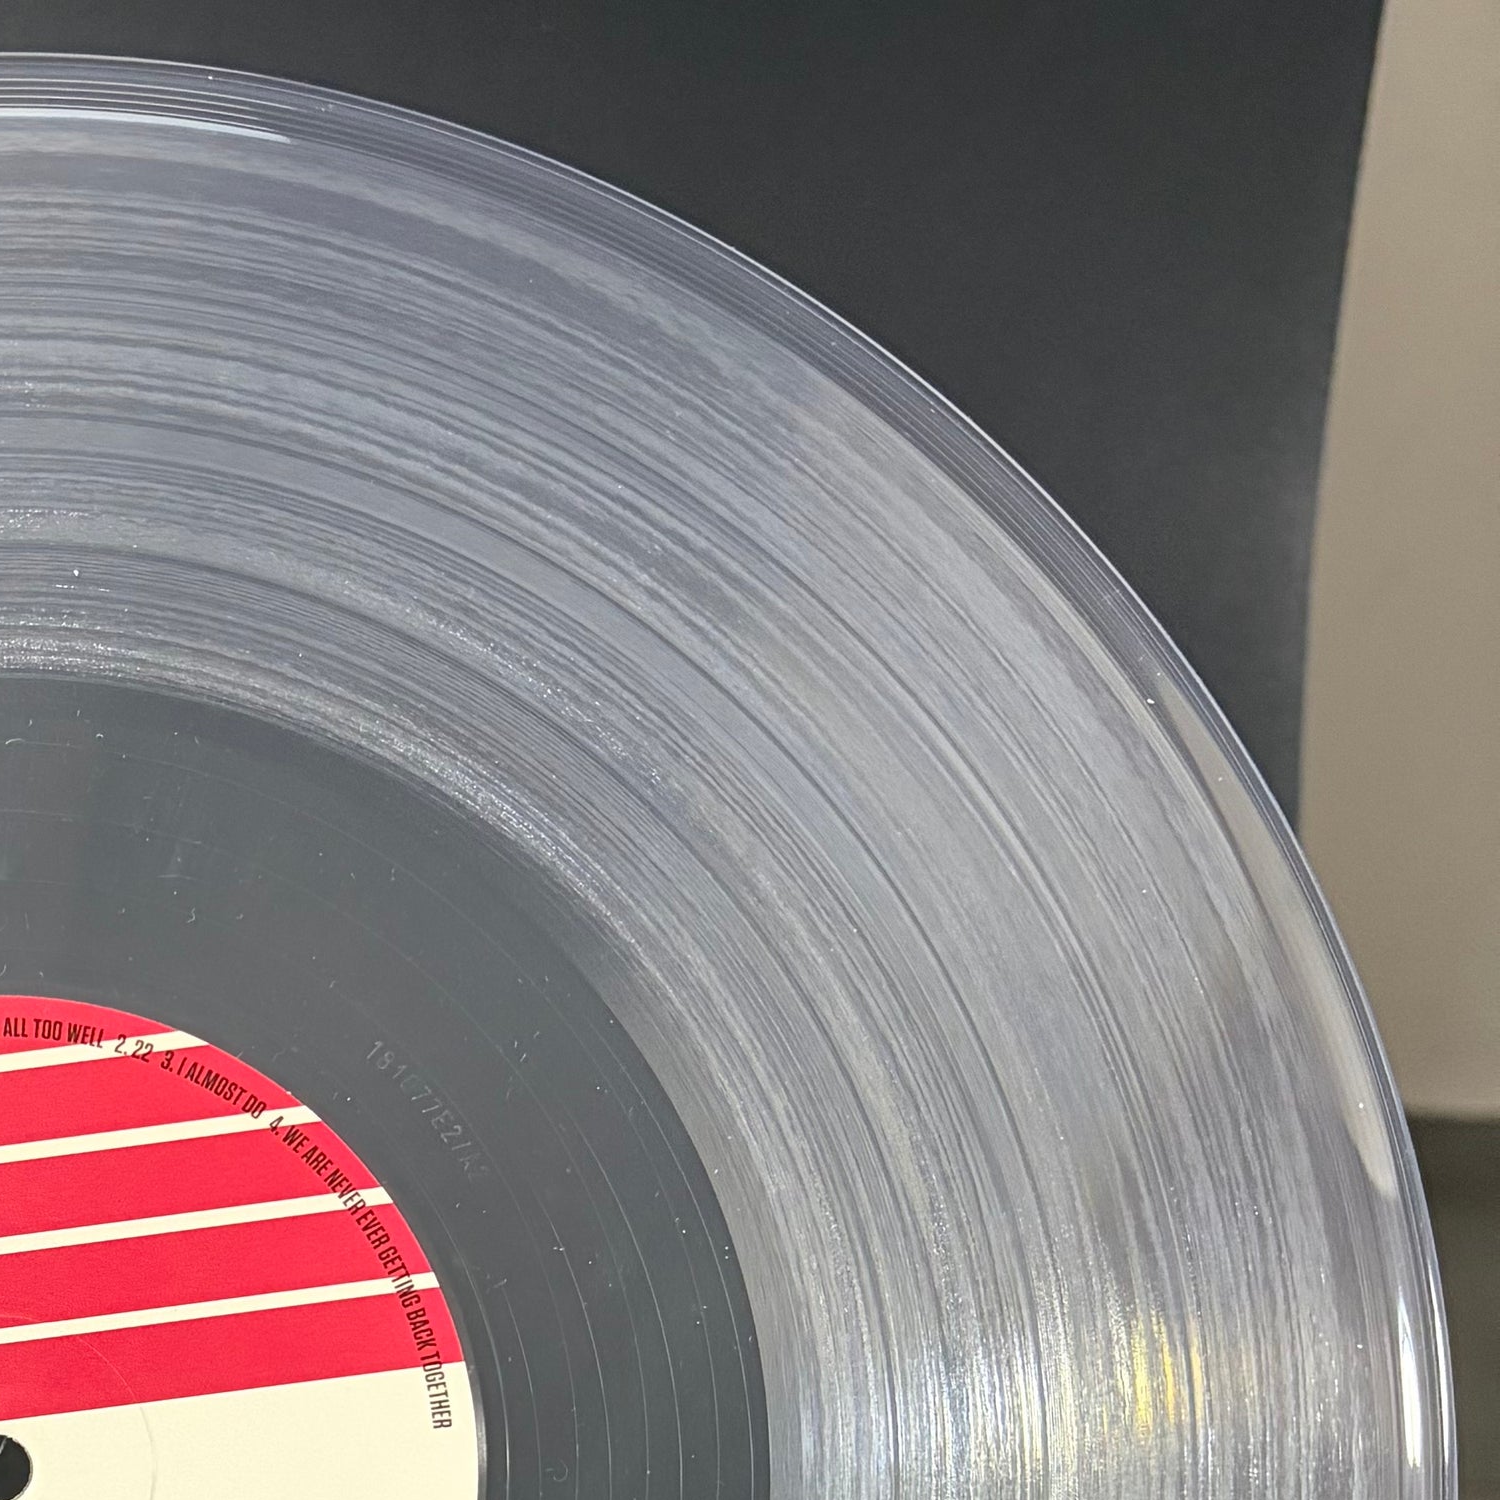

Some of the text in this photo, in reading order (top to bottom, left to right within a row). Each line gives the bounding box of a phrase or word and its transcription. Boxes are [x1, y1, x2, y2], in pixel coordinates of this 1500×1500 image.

[2, 1016, 29, 1037] ALL
[31, 1017, 63, 1041] TOO
[65, 1021, 107, 1049] WELL
[113, 1032, 155, 1063] 2. 22
[159, 1048, 269, 1121] 3. I ALMOST DO
[265, 1111, 453, 1430] 4. WE ARE NEVER EVER GETTING BACK TOGETHER
